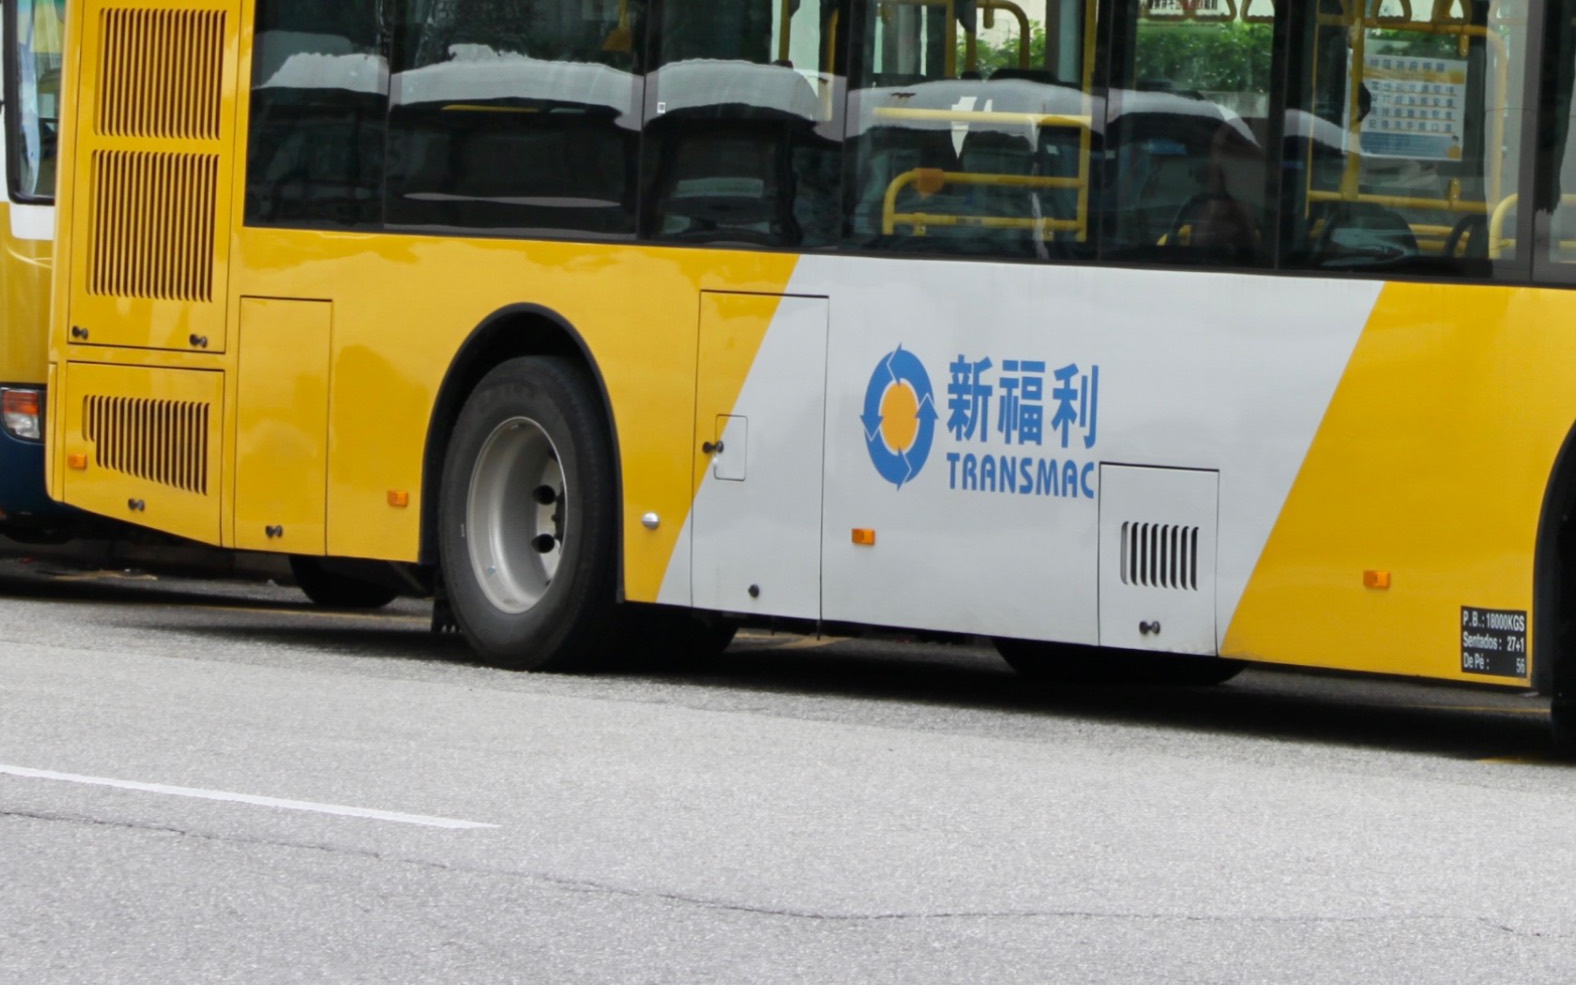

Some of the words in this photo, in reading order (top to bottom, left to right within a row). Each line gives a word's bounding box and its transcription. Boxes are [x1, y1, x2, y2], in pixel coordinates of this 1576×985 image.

[946, 354, 1099, 450] 新福利
[946, 452, 1095, 499] TRANSMAC
[1506, 636, 1525, 653] 27+1
